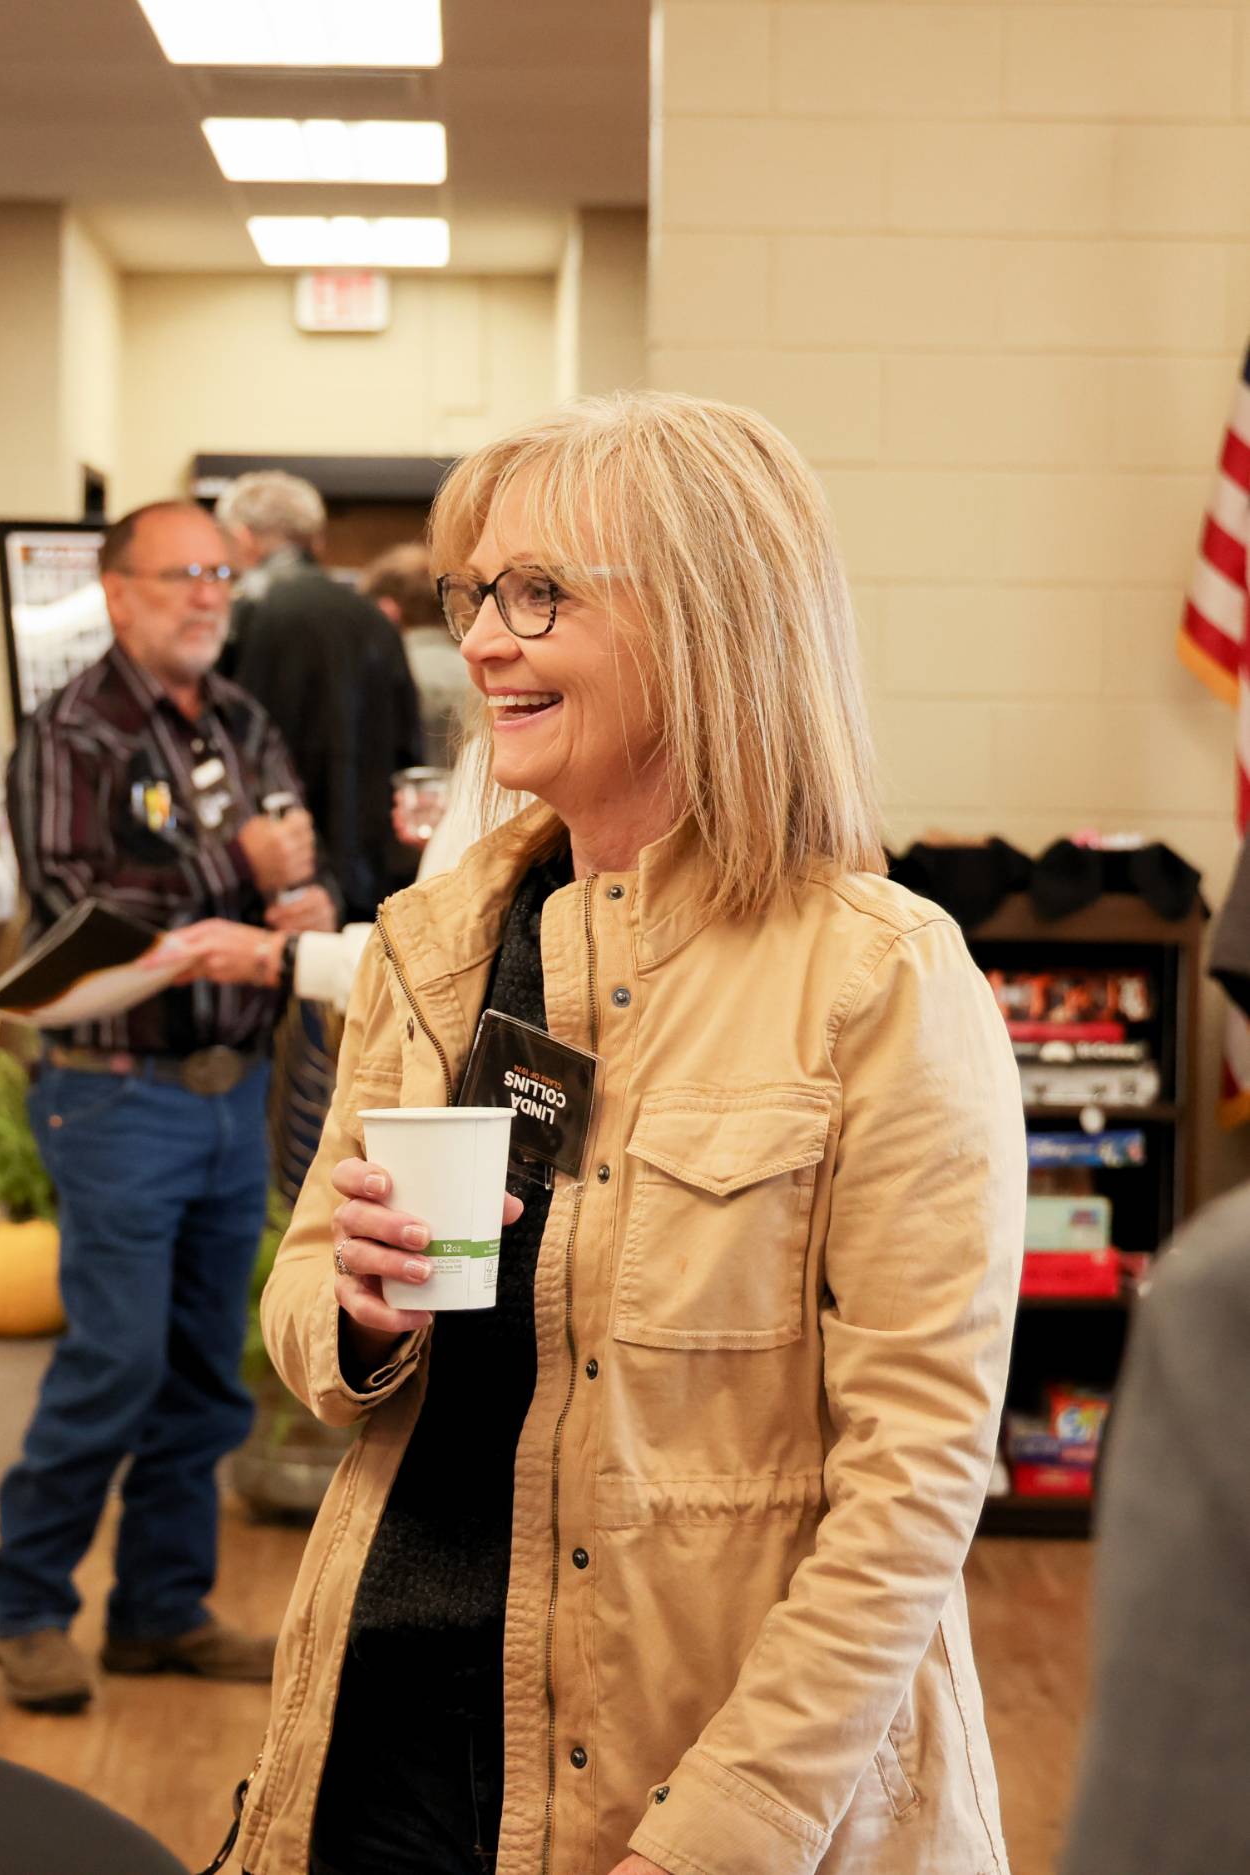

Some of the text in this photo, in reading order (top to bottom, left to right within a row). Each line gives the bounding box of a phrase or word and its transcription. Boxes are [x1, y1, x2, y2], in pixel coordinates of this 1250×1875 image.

[529, 1072, 540, 1081] OF
[541, 1075, 562, 1090] CLASS
[504, 1070, 566, 1108] COLLINS
[510, 1092, 555, 1125] LINDA
